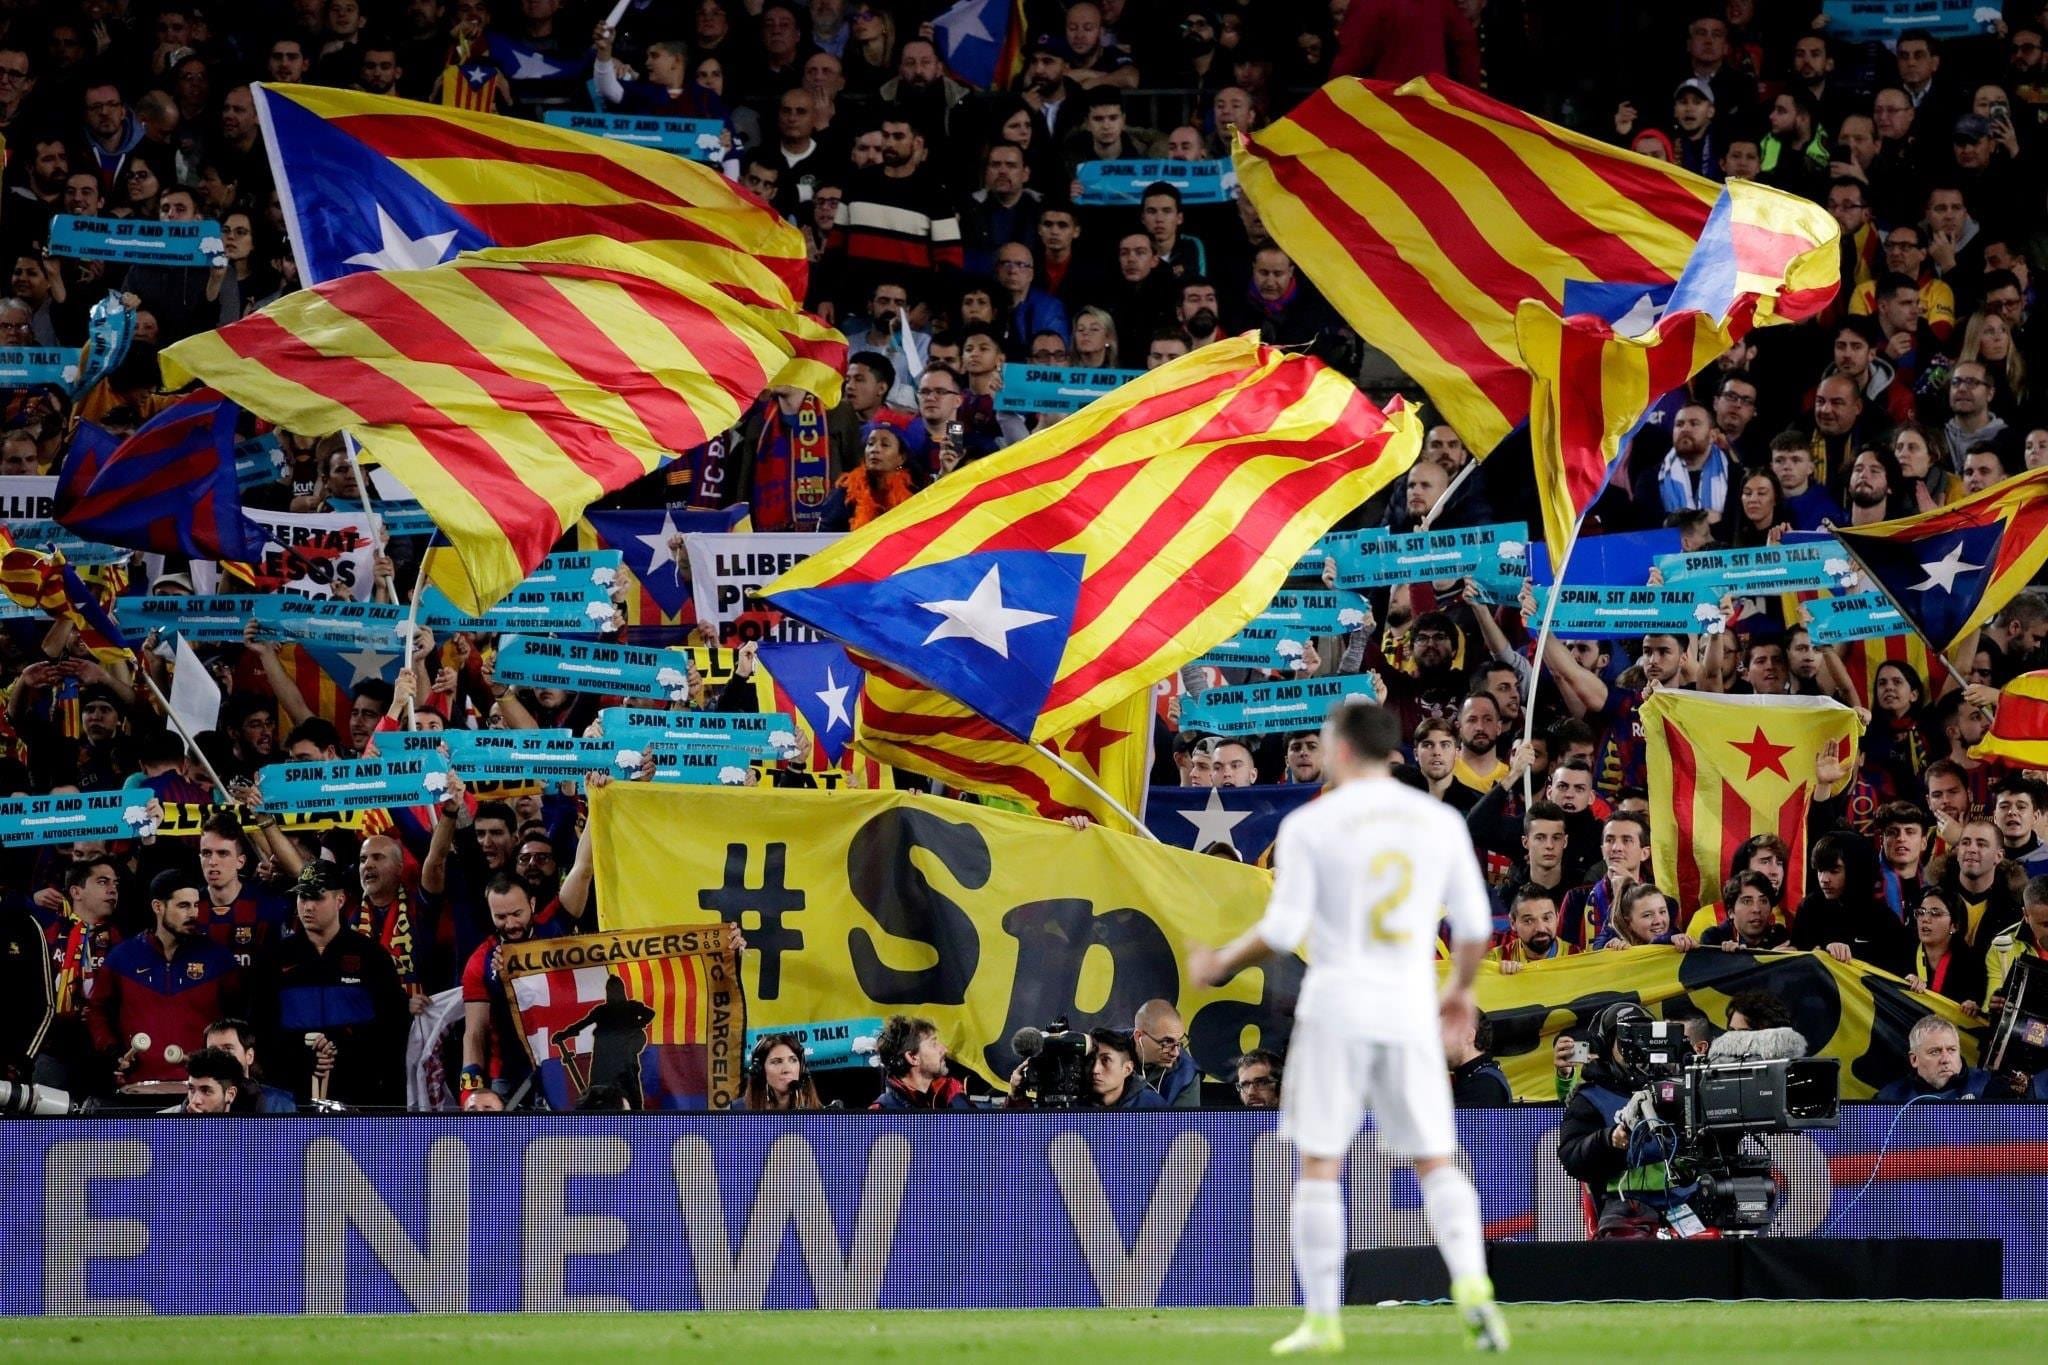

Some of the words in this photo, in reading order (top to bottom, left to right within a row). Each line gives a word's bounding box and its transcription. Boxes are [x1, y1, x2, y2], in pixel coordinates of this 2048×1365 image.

[613, 119, 630, 130] SIT
[635, 120, 659, 132] AND
[116, 224, 133, 236] SIT
[138, 225, 163, 237] AND
[169, 226, 199, 237] TALK!
[29, 352, 60, 365] TALK!
[1026, 370, 1064, 384] SPAIN,
[1070, 373, 1088, 384] SIT
[1092, 374, 1117, 386] AND
[1361, 541, 1402, 556] SPAIN,
[1407, 537, 1425, 551] SIT
[1430, 535, 1456, 549] AND
[558, 556, 591, 569] TALK!
[1685, 556, 1727, 571] SPAIN,
[1731, 554, 1749, 566] SIT
[1755, 551, 1781, 564] AND
[1785, 548, 1820, 561] TALK!
[210, 600, 235, 611] AND
[518, 592, 545, 604] AND
[551, 591, 584, 603] TALK!
[1303, 595, 1337, 609] TALK!
[1560, 591, 1601, 604] SPAIN,
[1607, 592, 1625, 604] SIT
[1629, 591, 1656, 604] AND
[1661, 591, 1695, 604] TALK!
[1831, 597, 1872, 613] SPAIN,
[281, 601, 316, 615] SPAIN,
[320, 604, 339, 615] SIT
[340, 605, 364, 617] AND
[368, 606, 400, 619] TALK!
[459, 618, 497, 627] LLIBERTAT
[1567, 620, 1606, 628] LLIBERTAT
[1614, 619, 1688, 629] AUTODETERMINACIÓ
[1243, 628, 1278, 640] TALK!
[524, 641, 565, 659] SPAIN,
[570, 646, 589, 660] SIT
[592, 649, 619, 662] AND
[624, 652, 657, 667] TALK!
[501, 671, 525, 681] DRETS
[532, 674, 571, 686] LLIBERTAT
[578, 678, 652, 693] AUTODETERMINACIÓ
[1206, 690, 1248, 707] SPAIN,
[1252, 687, 1271, 702] SIT
[1276, 686, 1302, 700] AND
[1307, 682, 1342, 697] TALK!
[629, 714, 670, 729] SPAIN,
[676, 715, 695, 729] SIT
[700, 716, 727, 730] AND
[732, 718, 767, 731] TALK!
[1217, 720, 1257, 731] LLIBERTAT
[475, 737, 517, 750] SPAIN,
[522, 739, 541, 750] SIT
[549, 739, 575, 750] AND
[580, 740, 615, 750] TALK!
[484, 764, 524, 774] LLIBERTAT
[683, 755, 718, 767] TALK!
[285, 767, 327, 782] SPAIN,
[332, 766, 350, 779] SIT
[355, 764, 383, 777] AND
[387, 760, 422, 775] TALK!
[0, 802, 27, 815] AIN,
[32, 800, 50, 814] SIT
[55, 799, 82, 811] AND
[88, 795, 122, 808] TALK!
[264, 801, 289, 811] DRETS
[296, 798, 336, 809] LLIBERTAT
[344, 791, 420, 805] AUTODETERMINACIÓ
[43, 826, 119, 839] AUTODETERMINACIÓ
[1369, 851, 1415, 944] 2
[507, 932, 699, 974] ALMOGÀVERS
[707, 951, 725, 982] FC
[813, 1025, 849, 1042] TALK!
[305, 1132, 913, 1315] NEW
